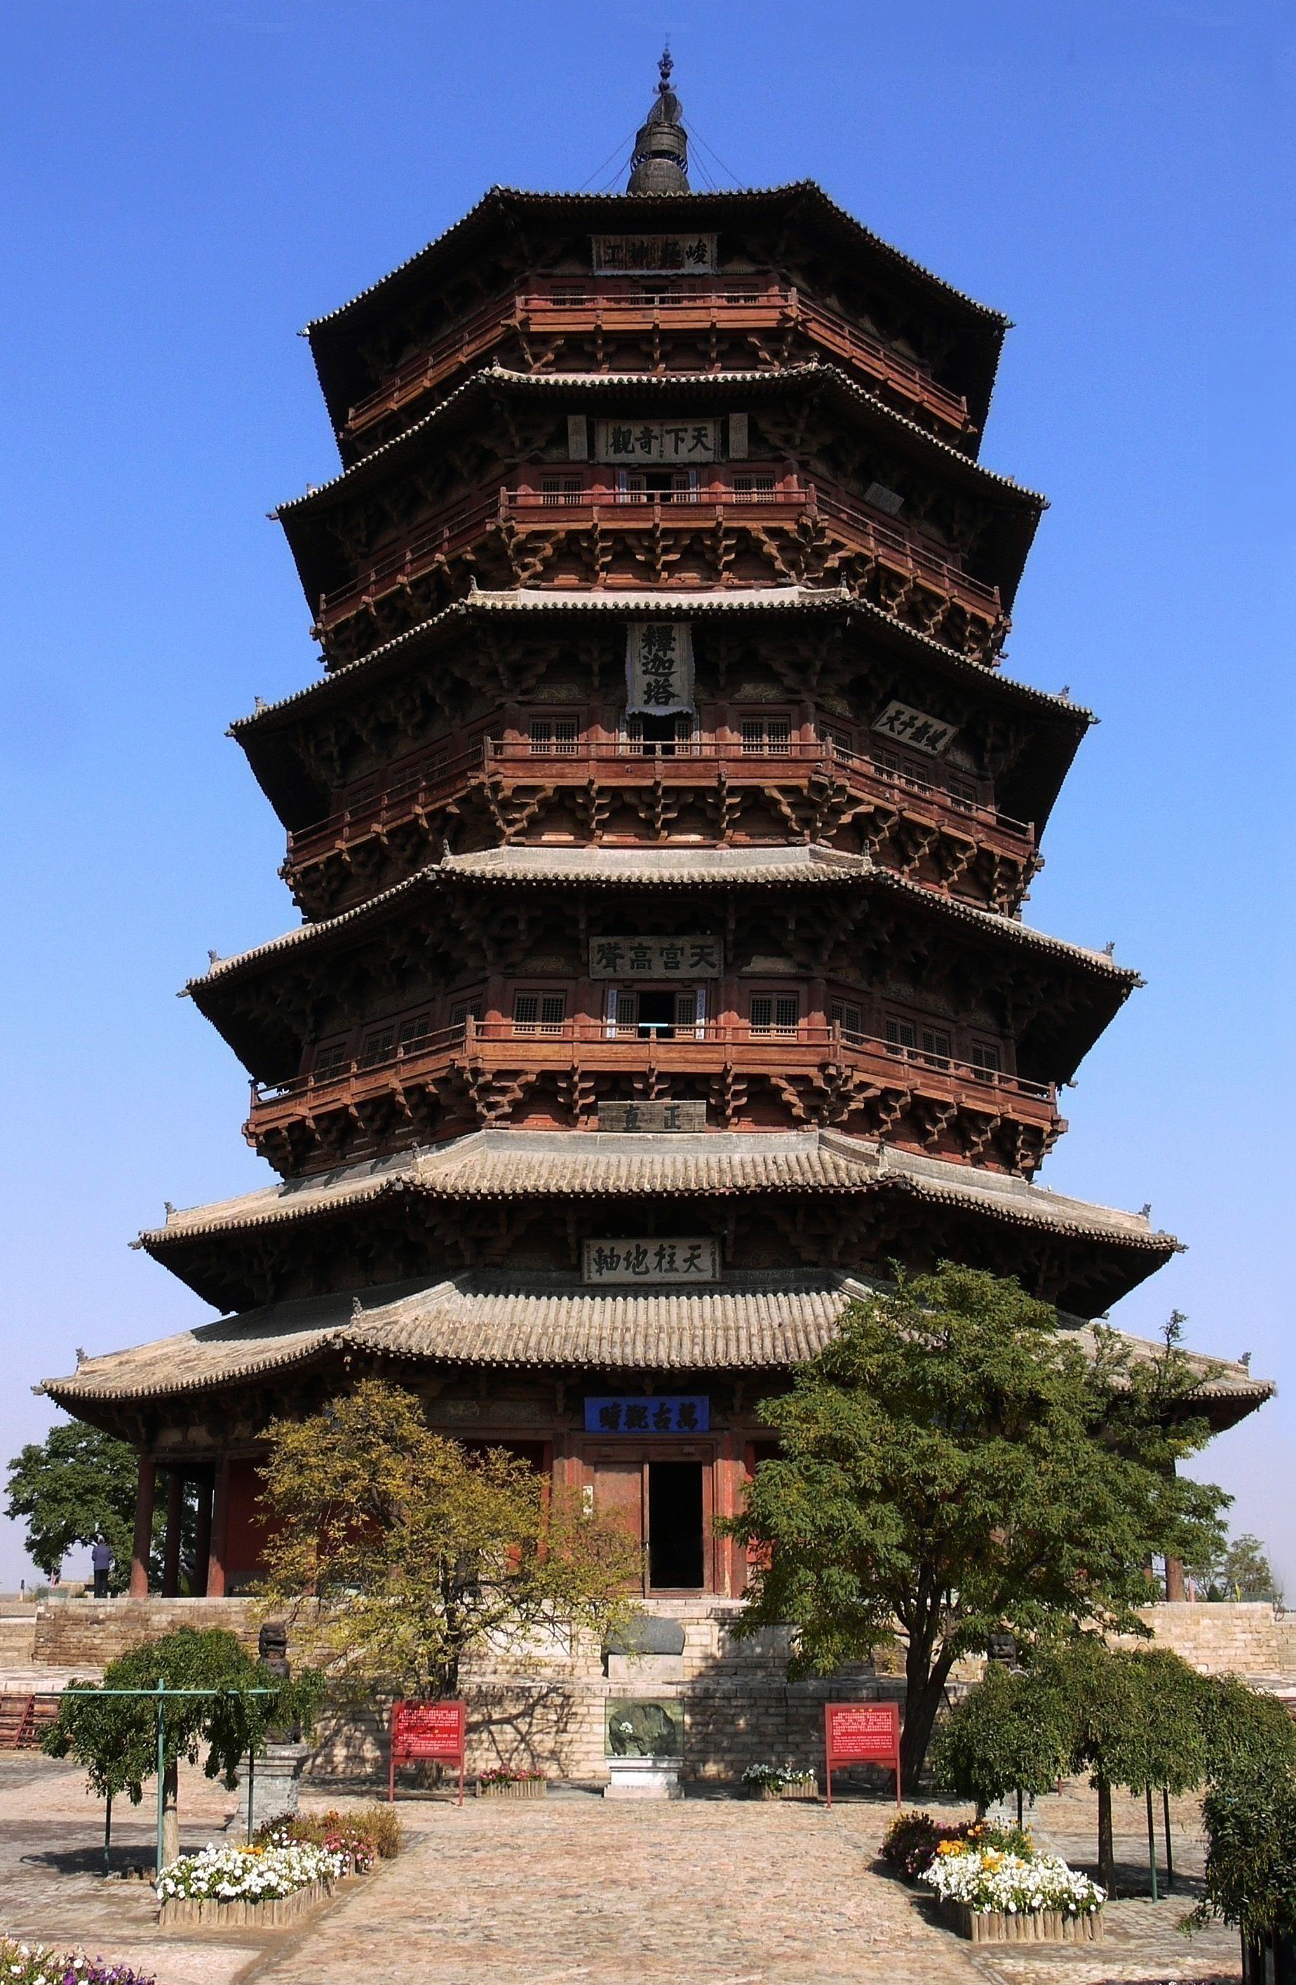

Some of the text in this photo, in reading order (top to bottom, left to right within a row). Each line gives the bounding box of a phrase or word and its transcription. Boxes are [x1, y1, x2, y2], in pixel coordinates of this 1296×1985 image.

[610, 426, 714, 454] 天下奇觀
[641, 624, 681, 706] 釋迦塔
[623, 1104, 681, 1130] 正直
[593, 1243, 708, 1276] 天柱地軸
